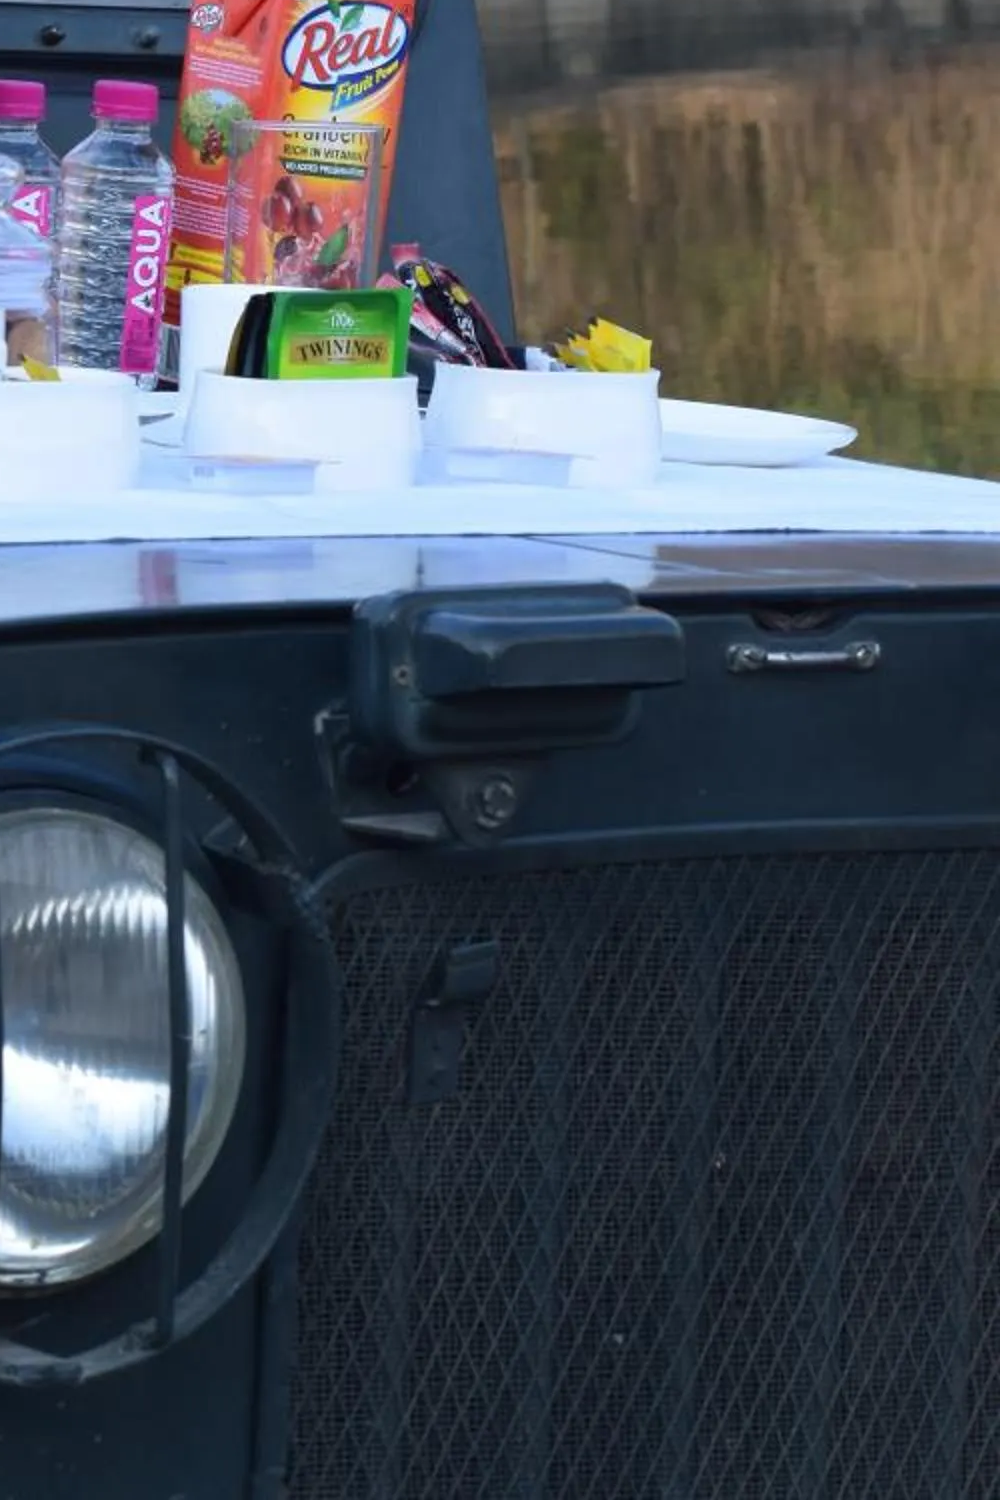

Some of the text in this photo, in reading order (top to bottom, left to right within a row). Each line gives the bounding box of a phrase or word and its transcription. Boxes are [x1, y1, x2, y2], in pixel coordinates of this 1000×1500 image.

[290, 6, 401, 93] Real
[131, 199, 164, 313] AQUA
[296, 338, 384, 362] TWININGS
